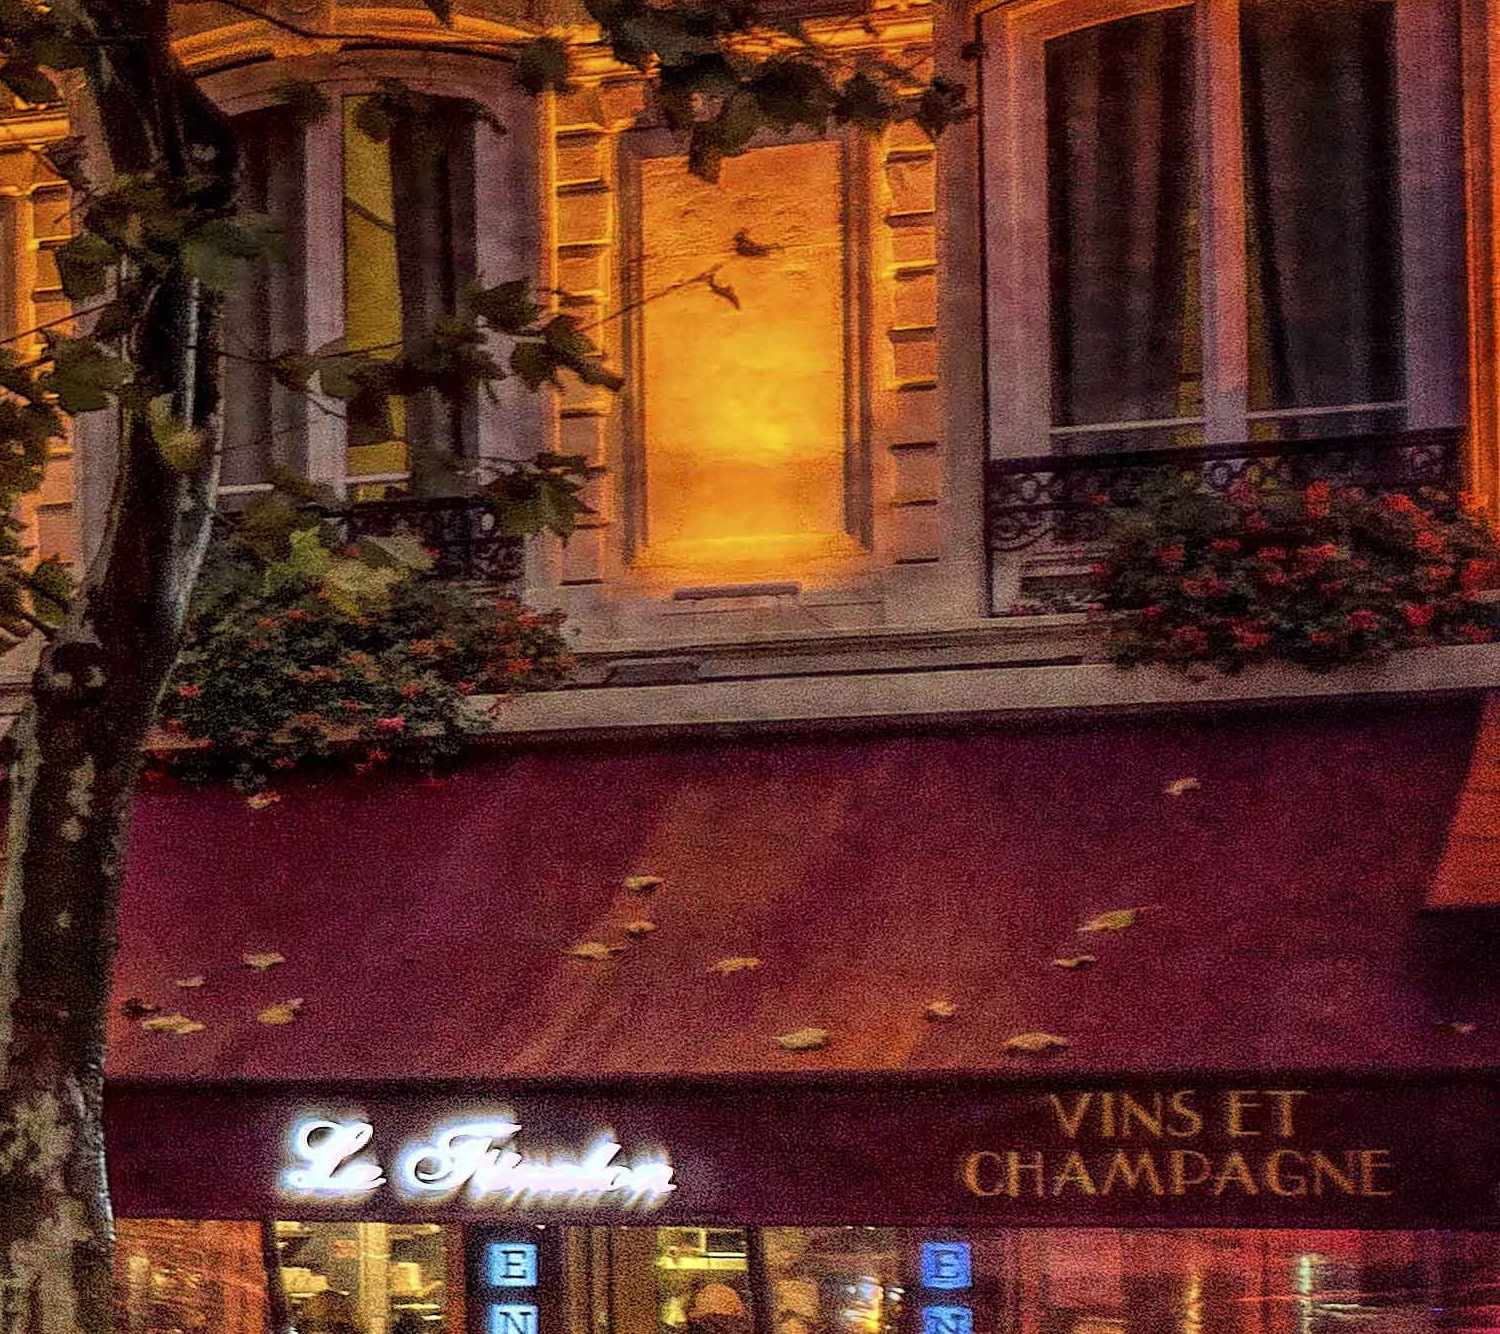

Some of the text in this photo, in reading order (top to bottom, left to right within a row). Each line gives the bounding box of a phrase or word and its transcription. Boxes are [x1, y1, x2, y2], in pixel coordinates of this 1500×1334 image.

[1050, 1090, 1308, 1137] VINS ET
[963, 1150, 1395, 1197] CHAMPAGNE
